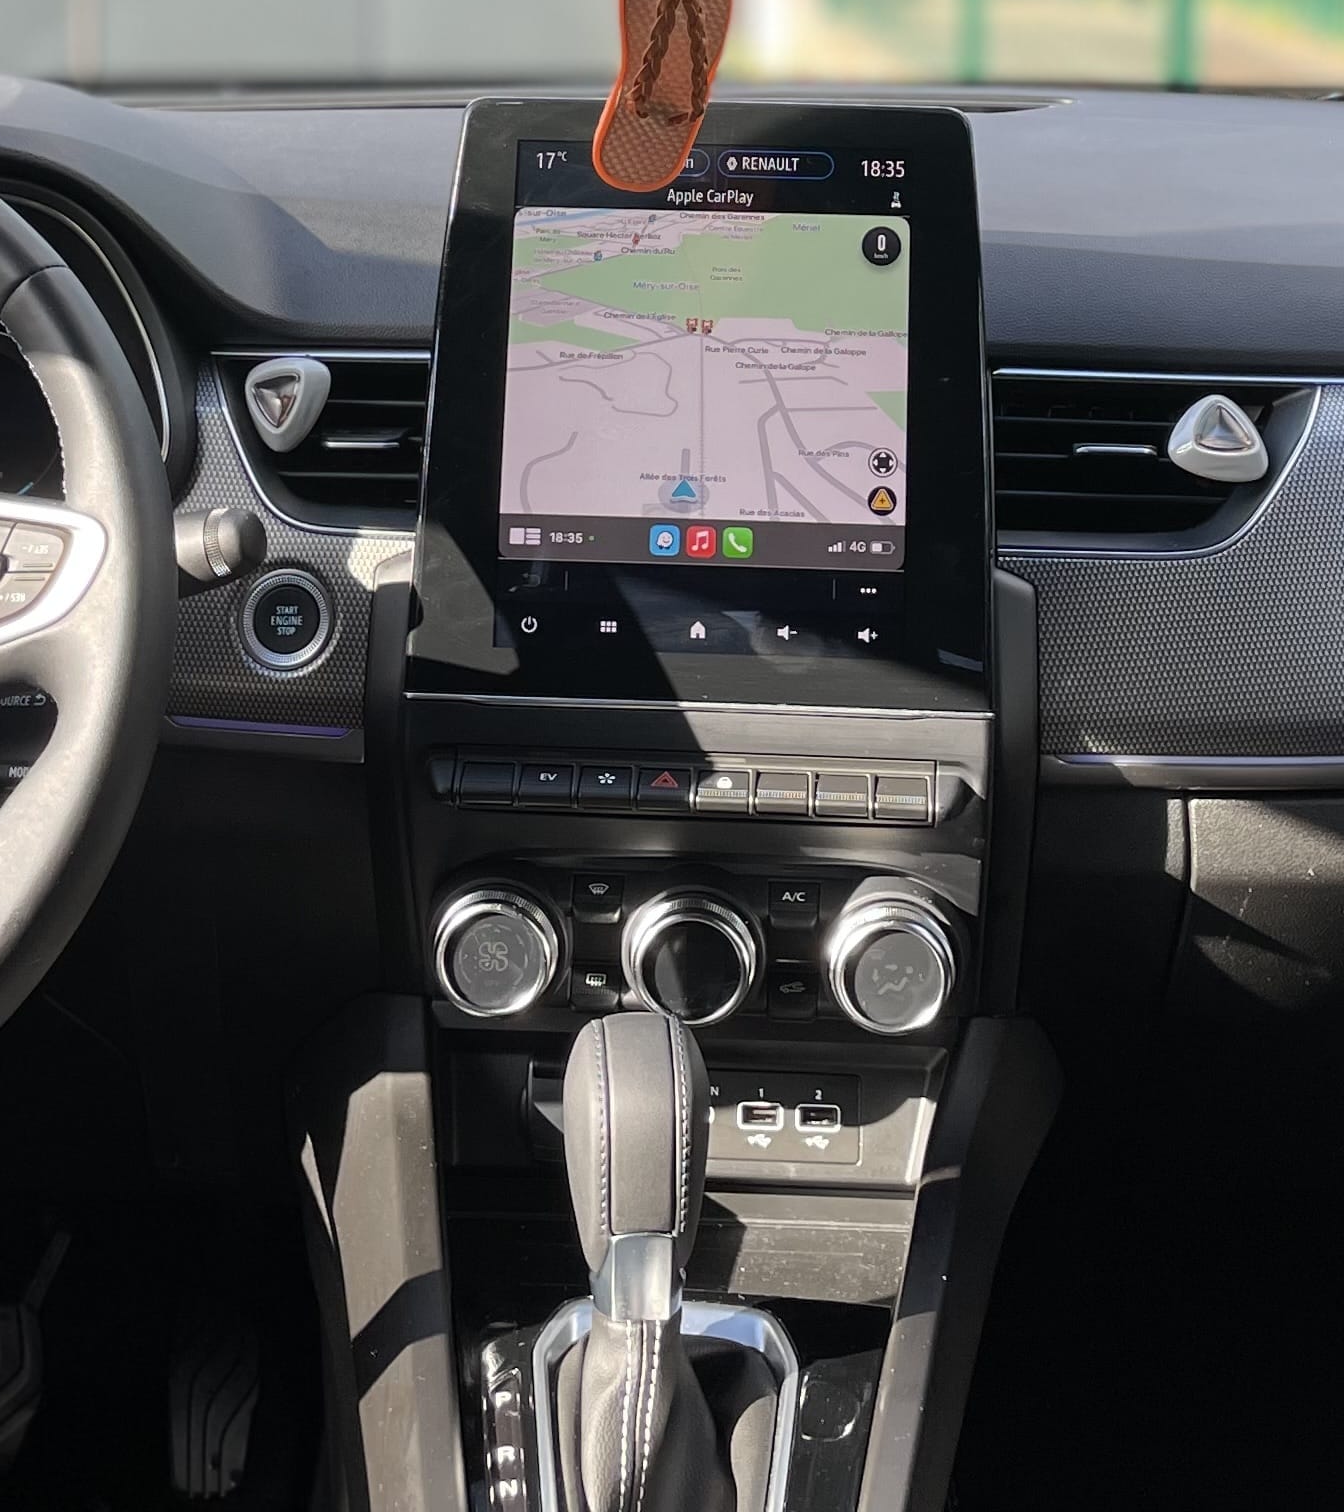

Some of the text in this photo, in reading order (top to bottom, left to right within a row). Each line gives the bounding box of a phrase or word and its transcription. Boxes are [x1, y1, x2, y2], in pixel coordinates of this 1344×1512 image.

[742, 156, 800, 172] RENAULT
[860, 160, 906, 178] 18:35
[667, 188, 754, 207] Apple CarPlay
[876, 233, 887, 252] 0
[621, 246, 651, 255] Chemin
[824, 328, 856, 336] Chemin
[705, 345, 722, 353] Rue
[780, 346, 811, 355] Chemin
[559, 351, 575, 359] Rue
[735, 361, 766, 370] Chemin
[798, 449, 813, 458] Rue
[739, 508, 756, 516] Rue
[549, 531, 584, 544] 18:35
[849, 540, 867, 553] 4G
[275, 605, 299, 615] START
[270, 615, 304, 626] ENGINE
[276, 626, 297, 636] STOP
[539, 772, 557, 782] EV
[782, 891, 806, 904] A/C
[758, 1087, 765, 1099] 1
[814, 1089, 823, 1101] 2
[494, 1391, 513, 1408] P
[497, 1445, 516, 1463] R
[499, 1480, 518, 1497] N
